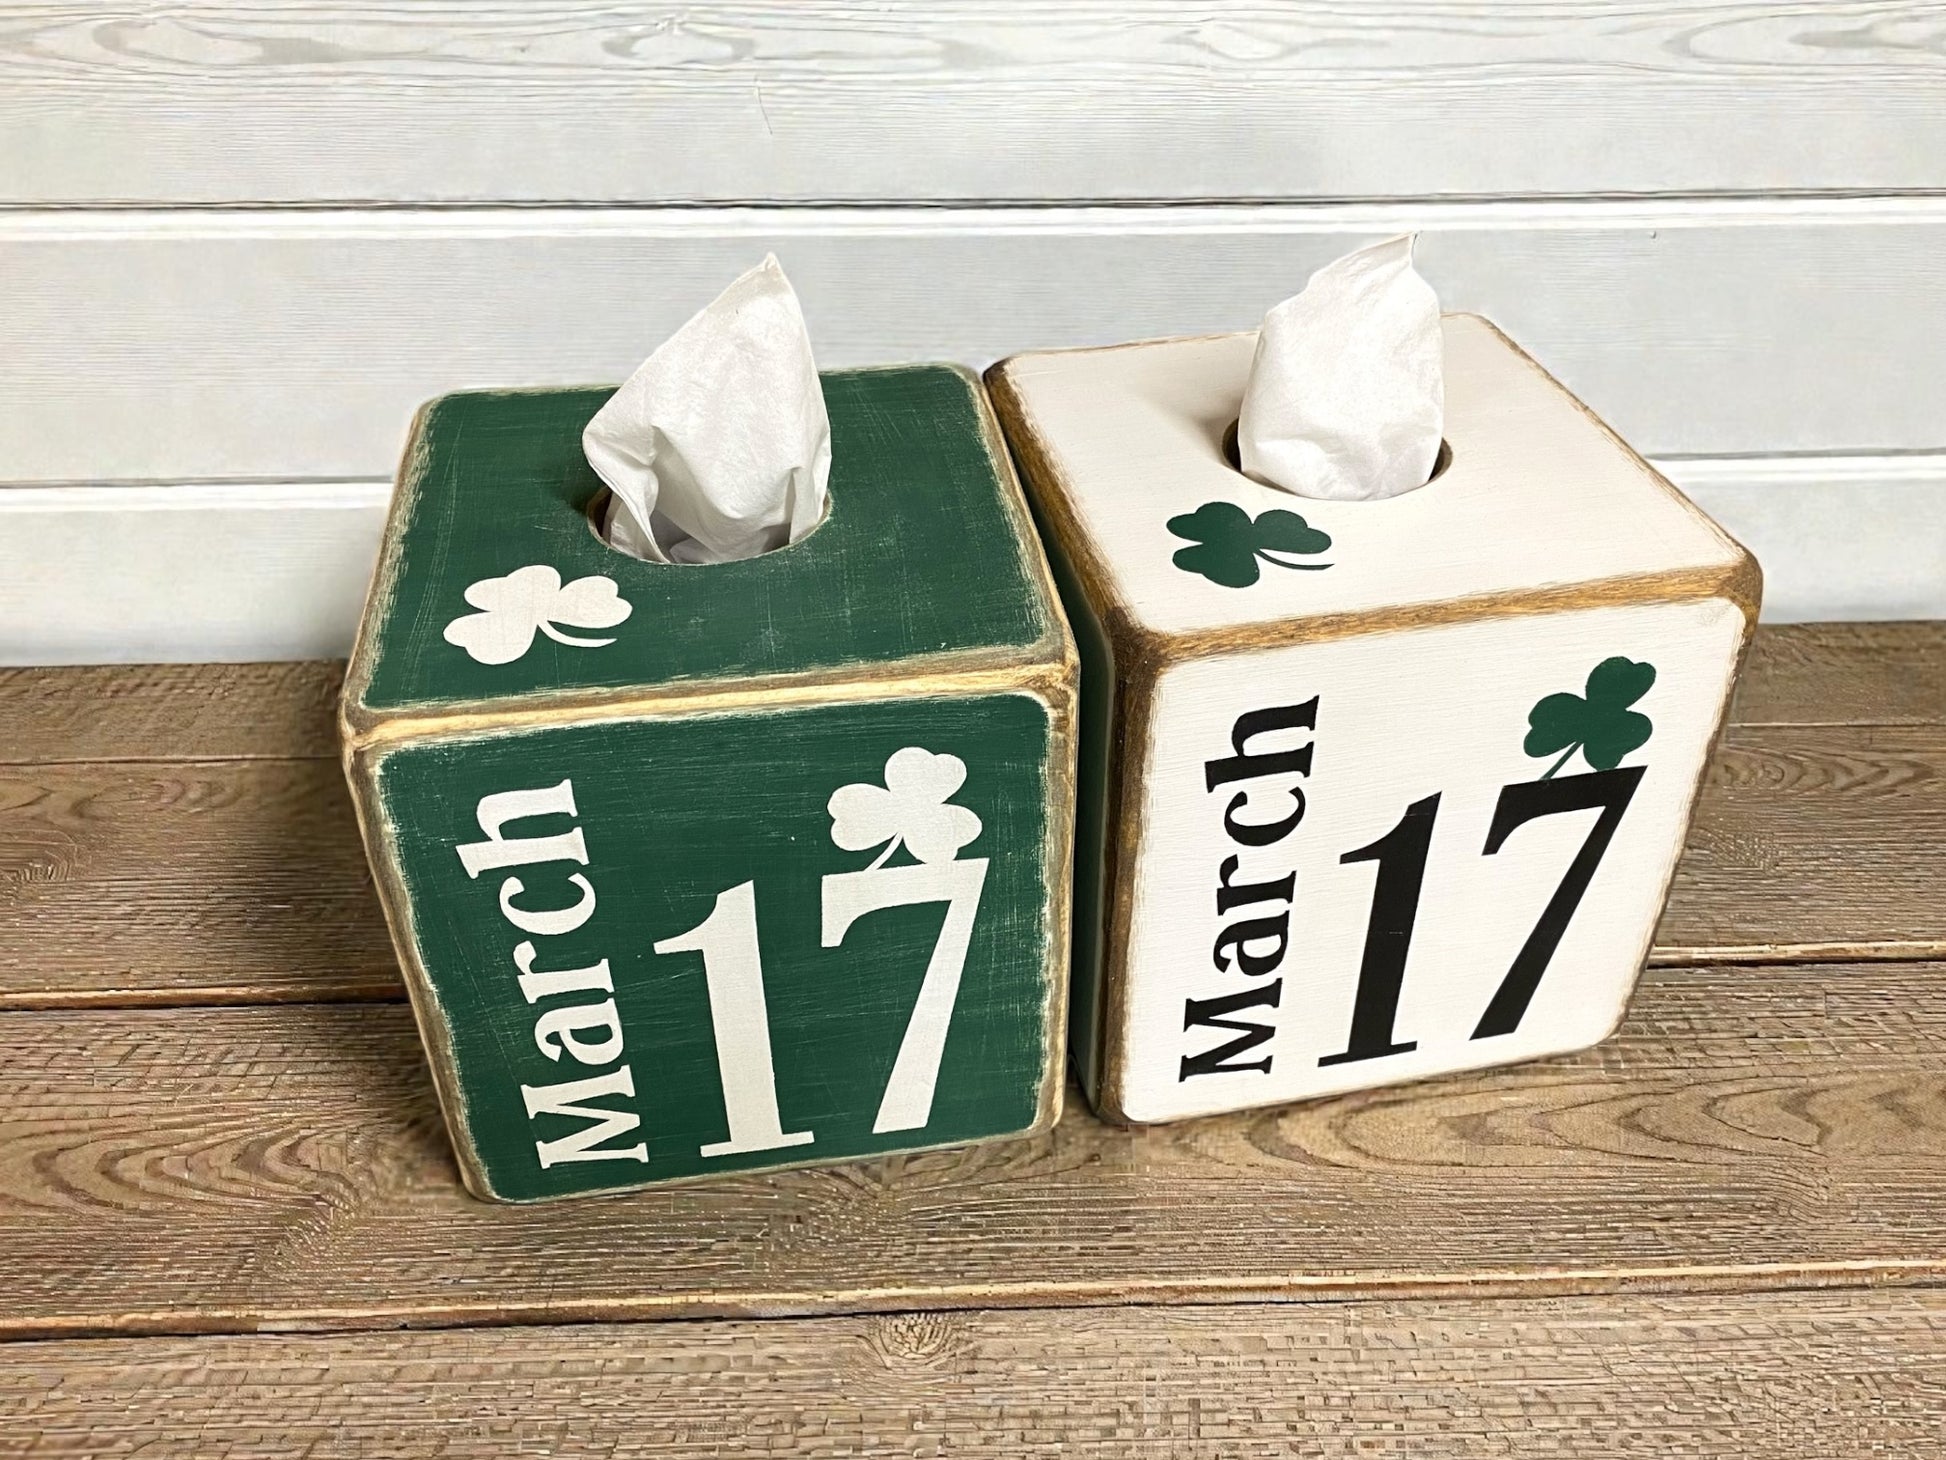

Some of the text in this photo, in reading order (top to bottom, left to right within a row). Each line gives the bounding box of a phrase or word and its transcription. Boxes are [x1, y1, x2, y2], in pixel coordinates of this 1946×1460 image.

[456, 779, 649, 1170] March
[653, 857, 989, 1158] 17
[1179, 695, 1320, 1083] March
[1318, 765, 1648, 1068] 17
